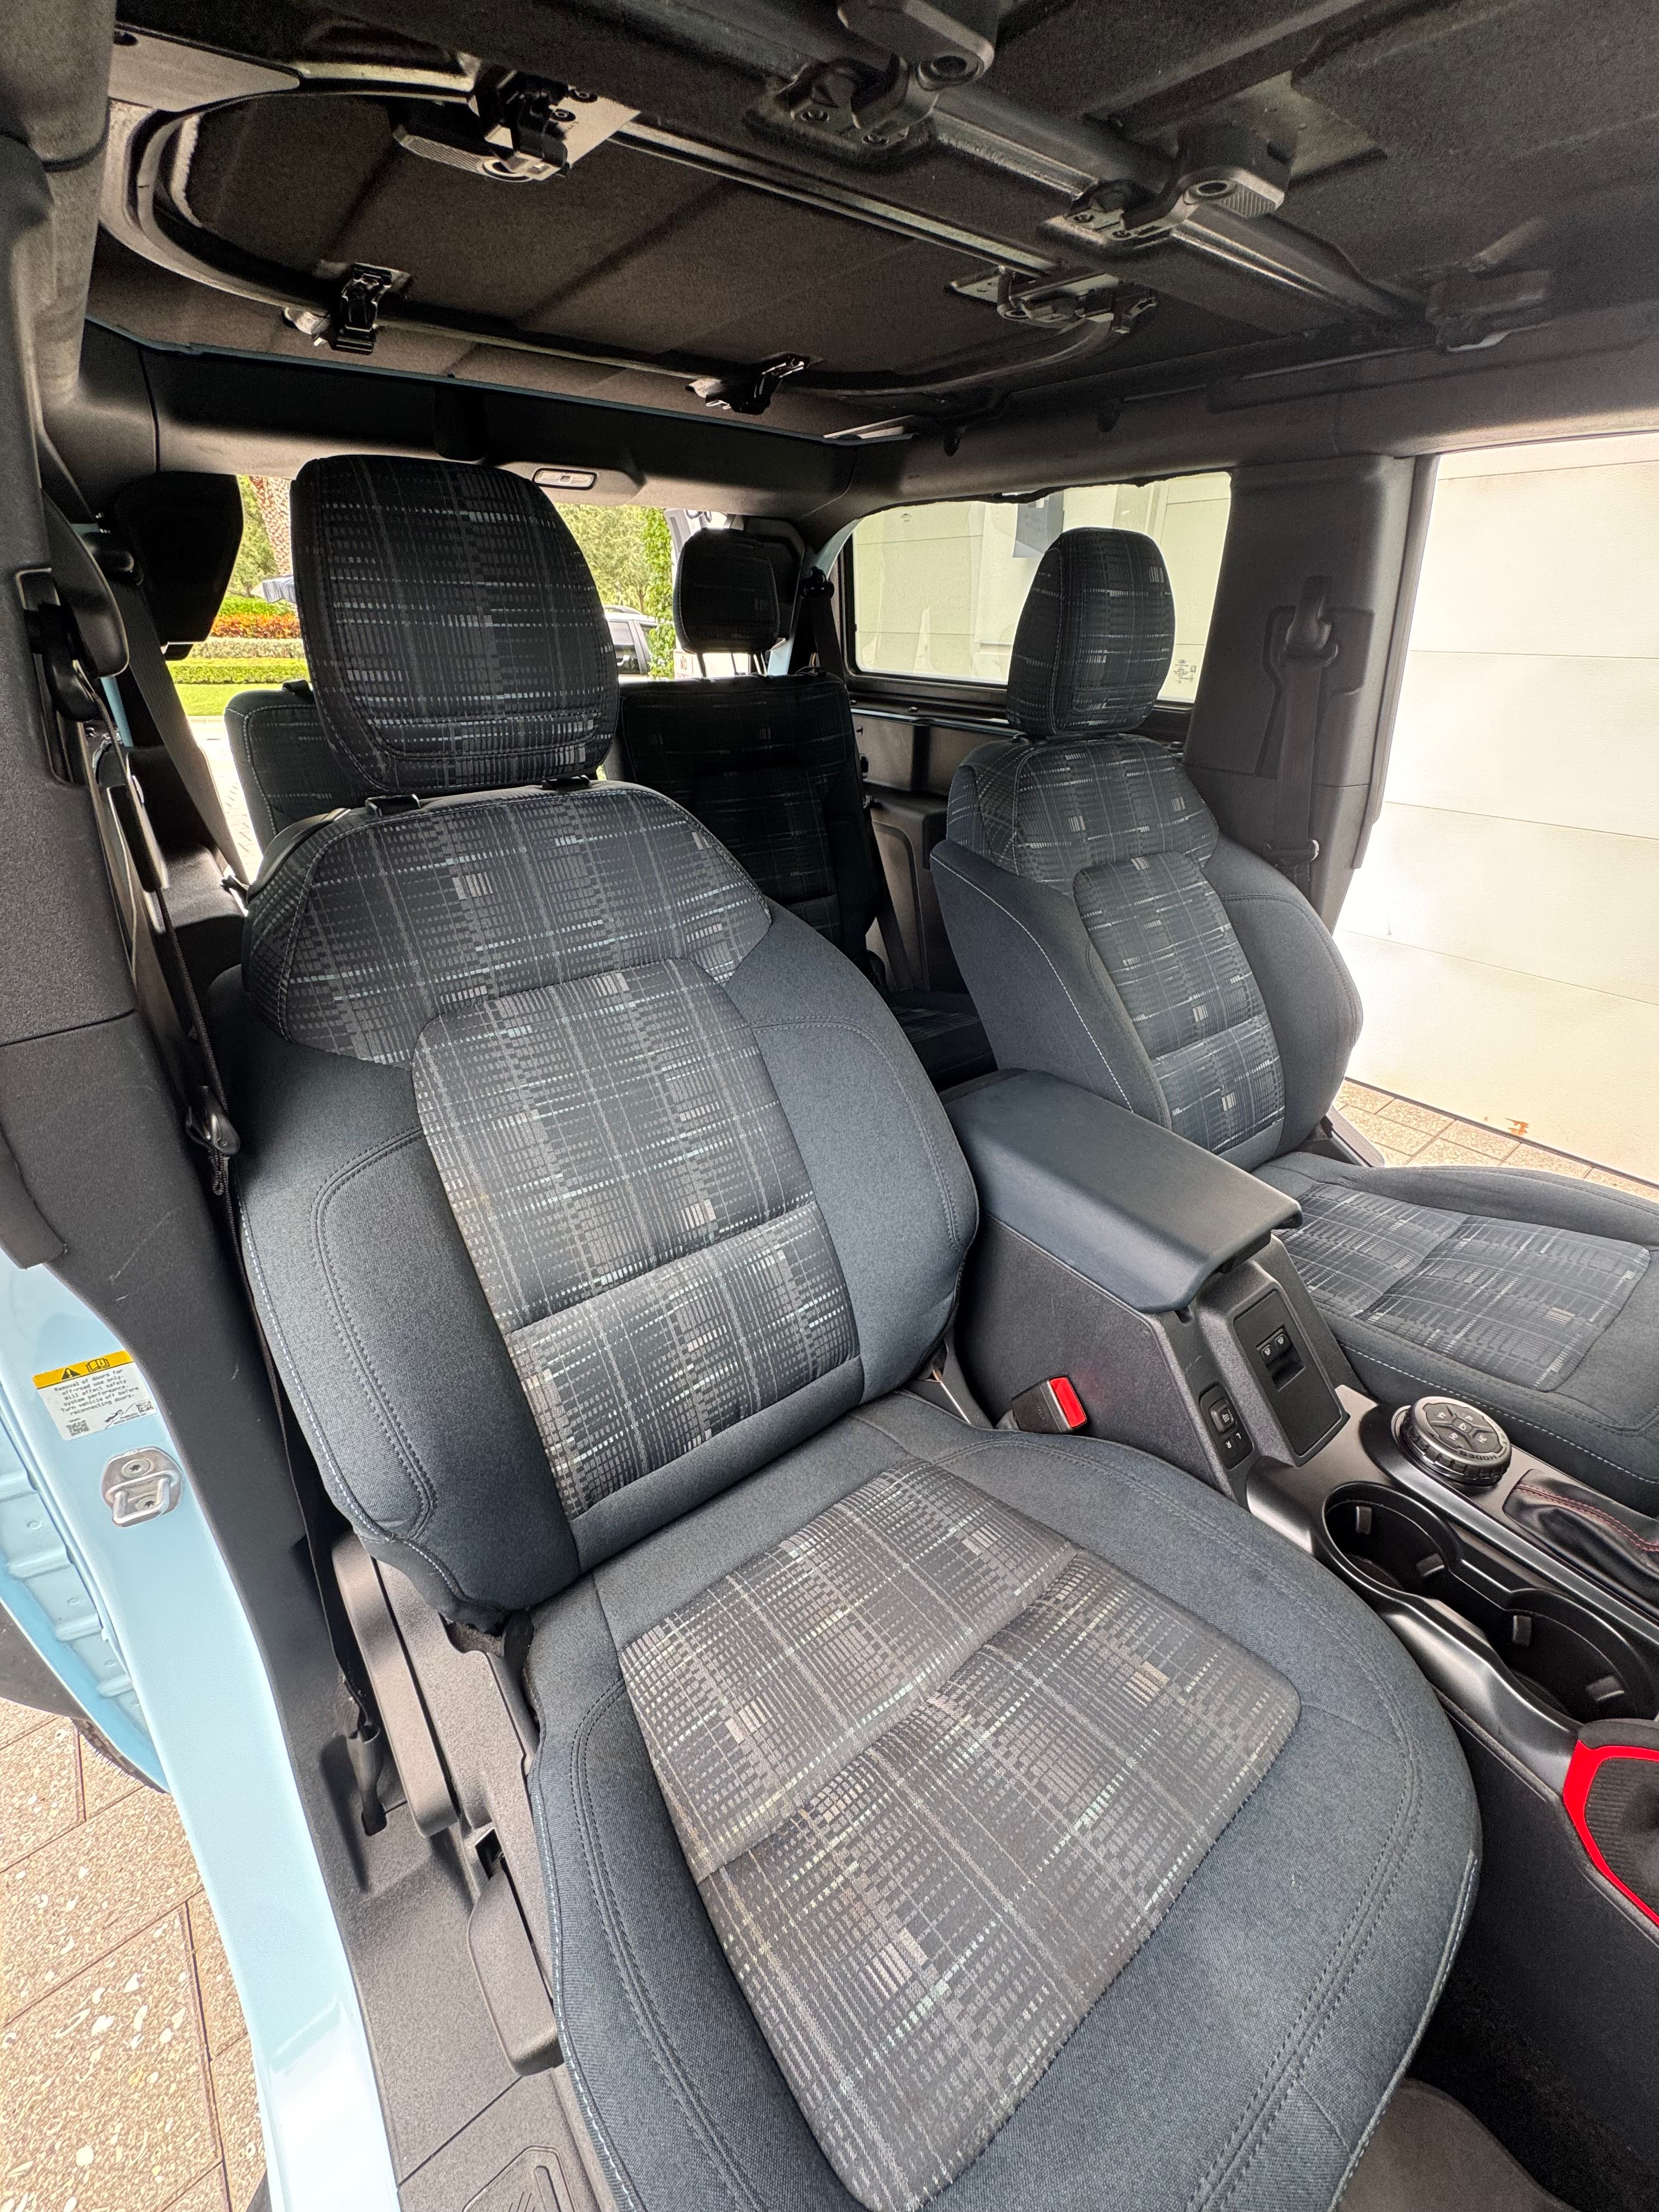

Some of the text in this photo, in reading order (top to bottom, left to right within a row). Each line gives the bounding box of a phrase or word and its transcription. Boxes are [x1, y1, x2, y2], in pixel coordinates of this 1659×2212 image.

[106, 1380, 126, 1388] safety
[61, 1384, 90, 1395] off-road
[63, 1397, 85, 1406] system
[78, 1397, 103, 1407] vehicle
[118, 1386, 139, 1395] before
[70, 1401, 112, 1415] reconnecting
[1459, 1451, 1498, 1460] MODES
